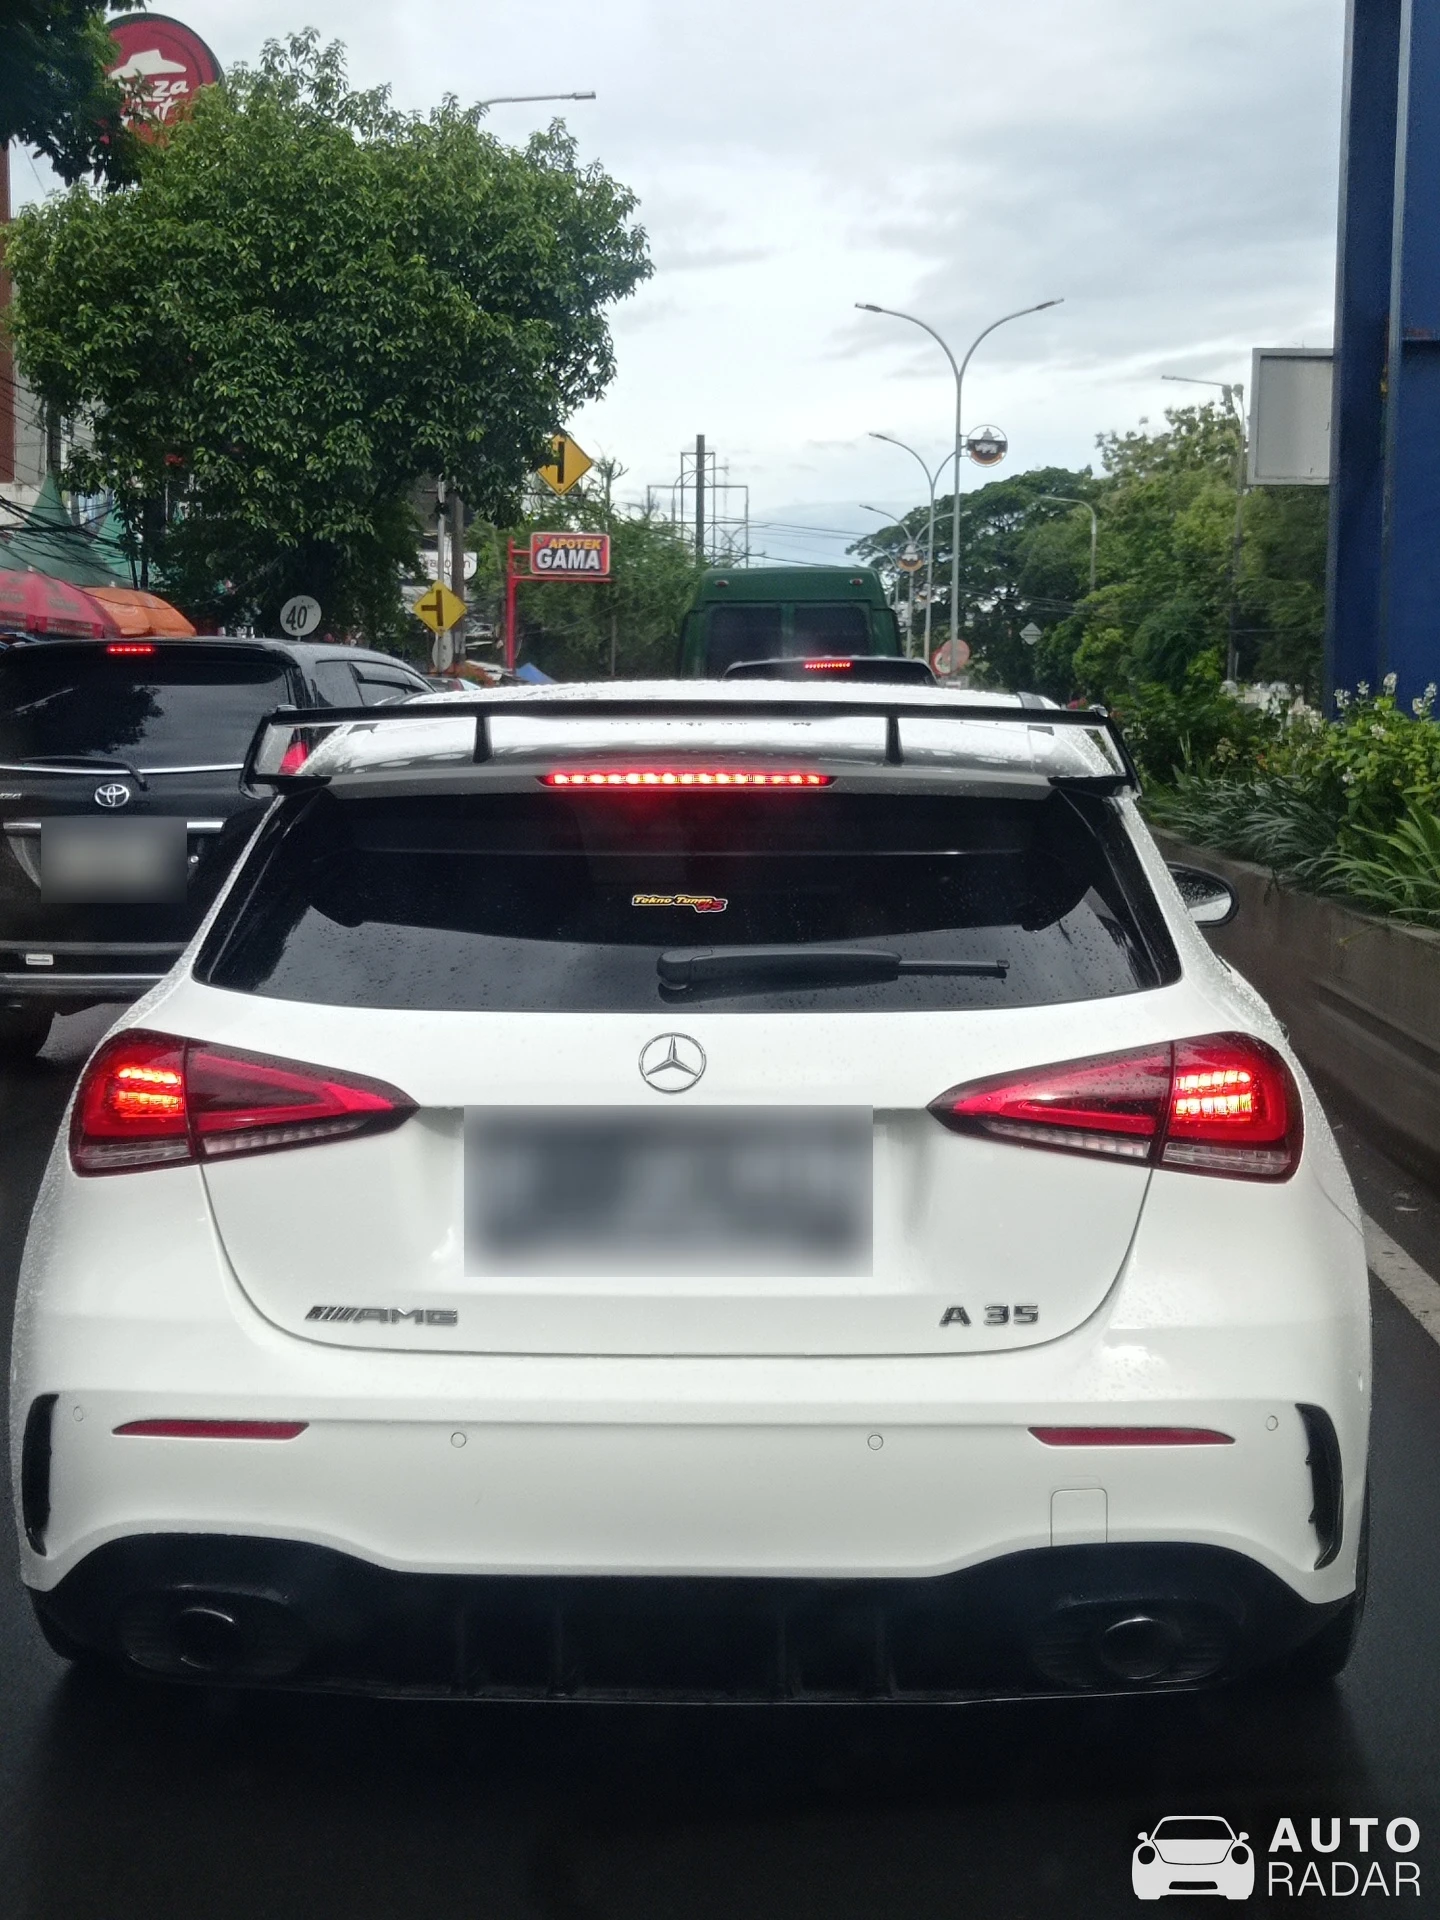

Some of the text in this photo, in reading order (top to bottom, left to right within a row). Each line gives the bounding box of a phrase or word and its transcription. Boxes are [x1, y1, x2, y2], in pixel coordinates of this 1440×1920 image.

[548, 538, 602, 549] APOTEK
[536, 548, 600, 570] GAMA
[285, 605, 308, 630] 40
[634, 896, 672, 904] Tekno
[939, 1303, 1039, 1326] A 35
